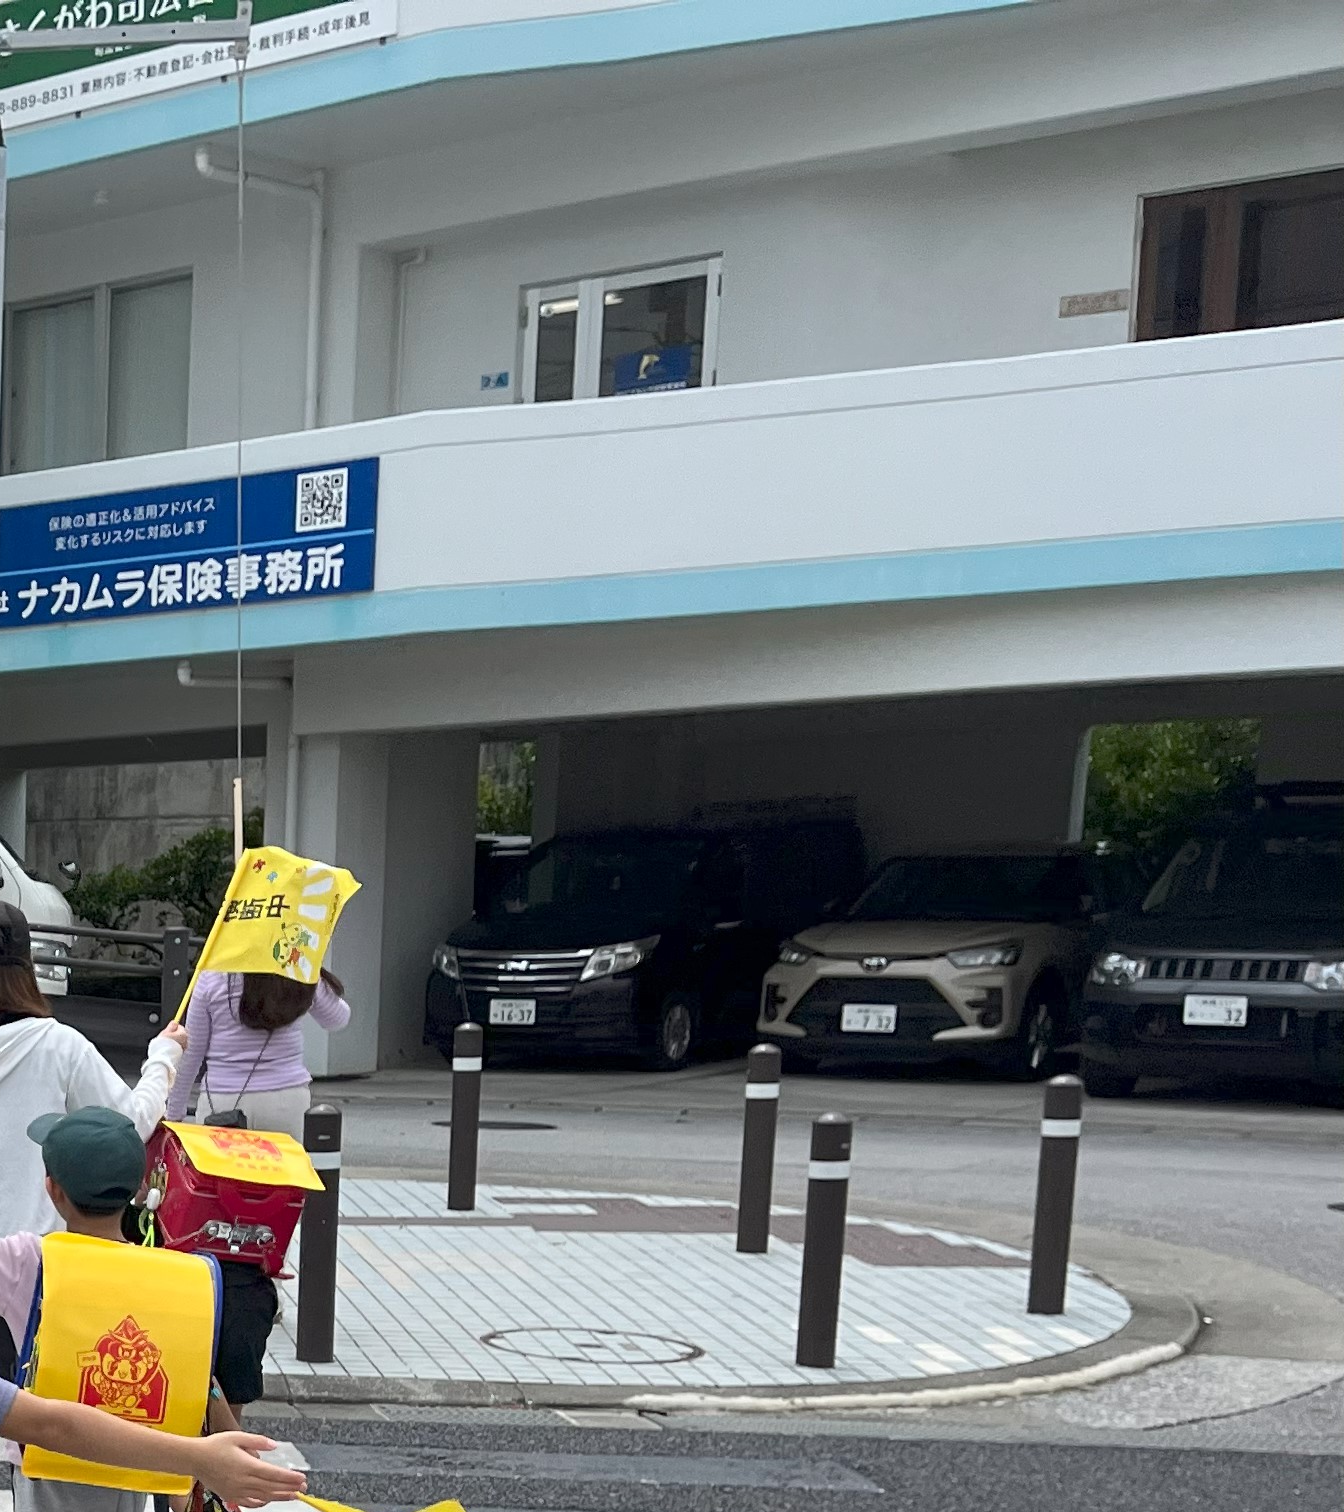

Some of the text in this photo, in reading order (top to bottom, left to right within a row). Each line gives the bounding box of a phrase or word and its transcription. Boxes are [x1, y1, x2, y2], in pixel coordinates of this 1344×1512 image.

[55, 519, 208, 552] 変化するリスクに対応します
[18, 543, 345, 620] ナカムラ保険事務所
